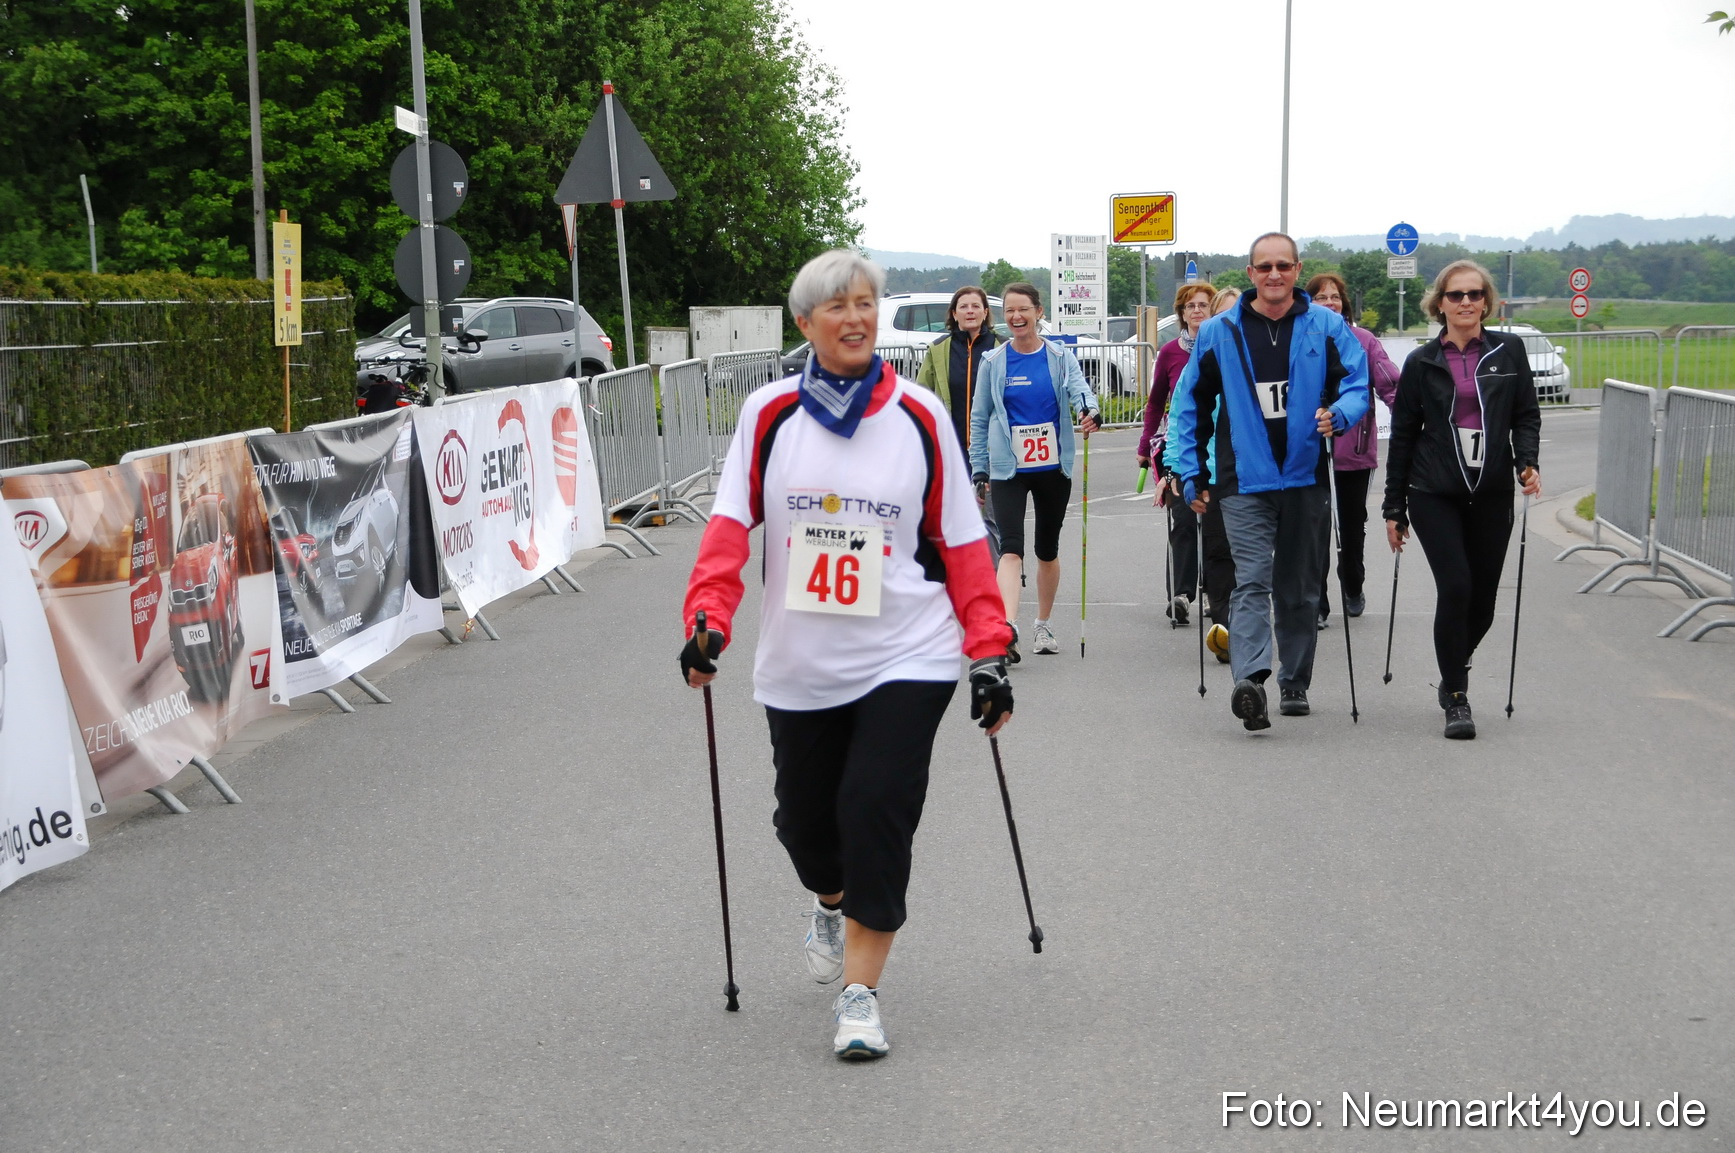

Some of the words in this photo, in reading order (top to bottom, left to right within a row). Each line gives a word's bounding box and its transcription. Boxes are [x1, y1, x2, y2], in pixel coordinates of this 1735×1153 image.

[1118, 202, 1168, 216] Sengenthal
[1140, 216, 1161, 225] Anger
[1574, 275, 1586, 286] 60
[1064, 303, 1082, 315] THULE
[280, 317, 285, 342] 5
[286, 316, 297, 341] km
[1023, 437, 1050, 462] 25
[270, 459, 290, 485] FÜR
[303, 458, 319, 481] UND
[443, 448, 464, 488] KIA
[443, 520, 474, 559] MOTORS
[805, 527, 846, 540] MEYER
[805, 538, 847, 549] WERBUNG
[806, 552, 860, 606] 46
[189, 629, 205, 642] RIO
[285, 636, 313, 656] NEUE
[153, 697, 175, 726] KIA
[170, 690, 195, 721] RIO.
